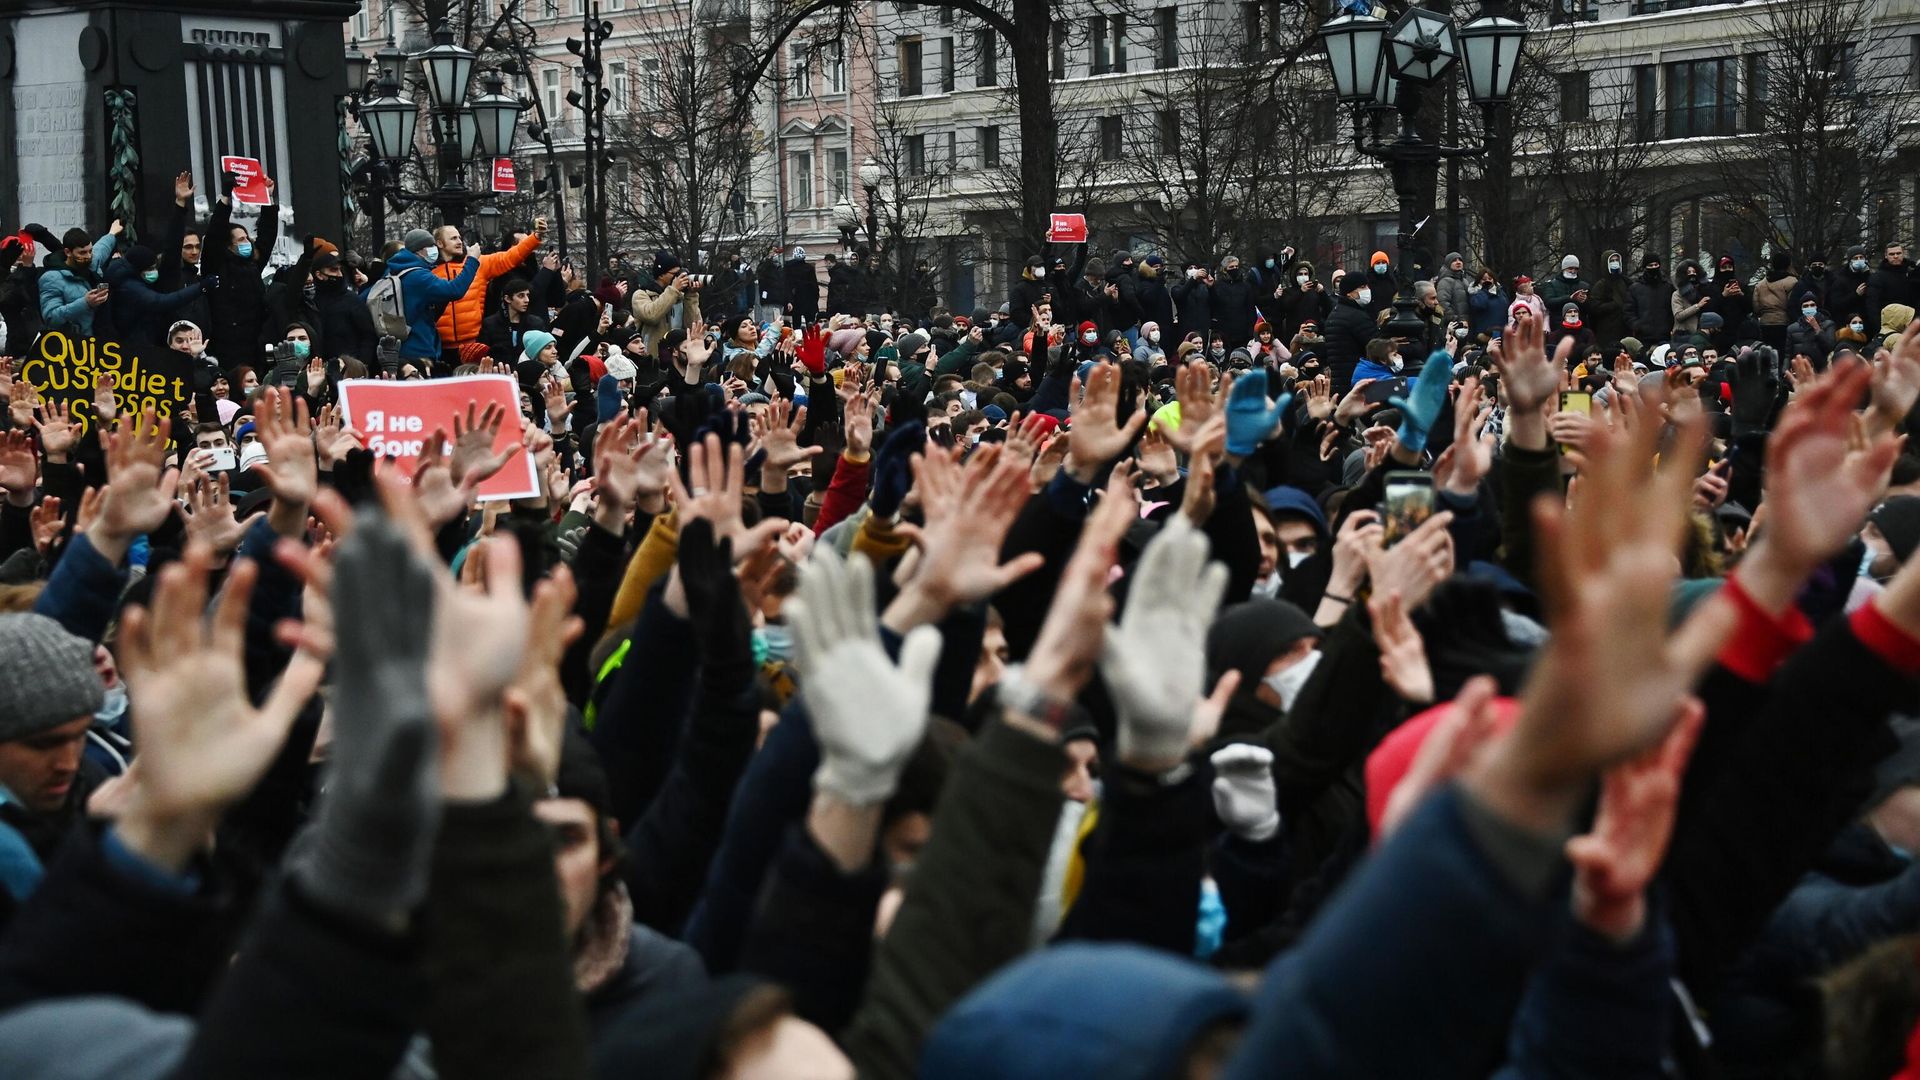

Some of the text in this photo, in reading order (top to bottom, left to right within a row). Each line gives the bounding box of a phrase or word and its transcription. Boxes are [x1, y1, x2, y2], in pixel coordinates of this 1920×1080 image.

[365, 410, 423, 433] Я не
[368, 434, 454, 459] боюь
